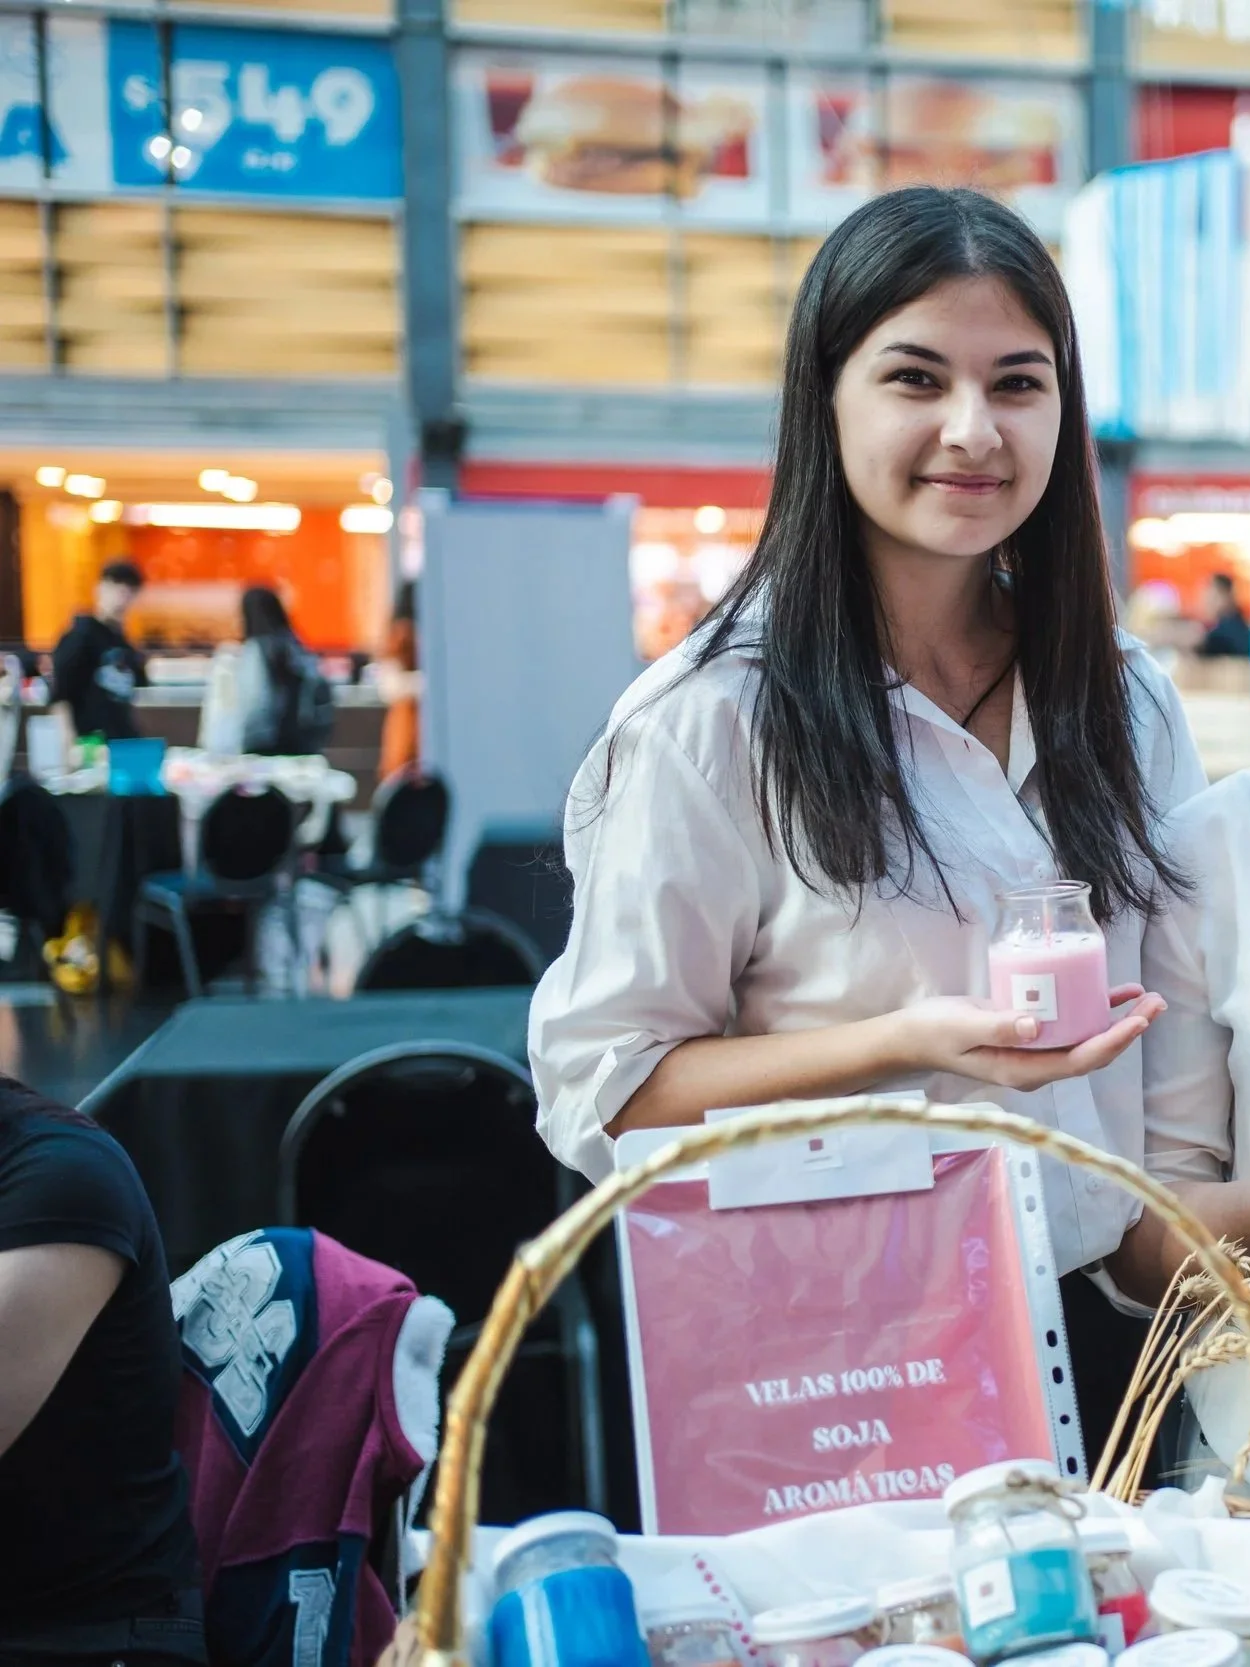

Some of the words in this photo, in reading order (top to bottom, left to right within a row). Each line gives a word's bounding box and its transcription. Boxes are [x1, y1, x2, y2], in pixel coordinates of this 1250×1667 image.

[744, 1373, 836, 1407] VELAS
[840, 1365, 904, 1395] 100%
[906, 1358, 946, 1385] DE
[812, 1419, 893, 1452] SOJA
